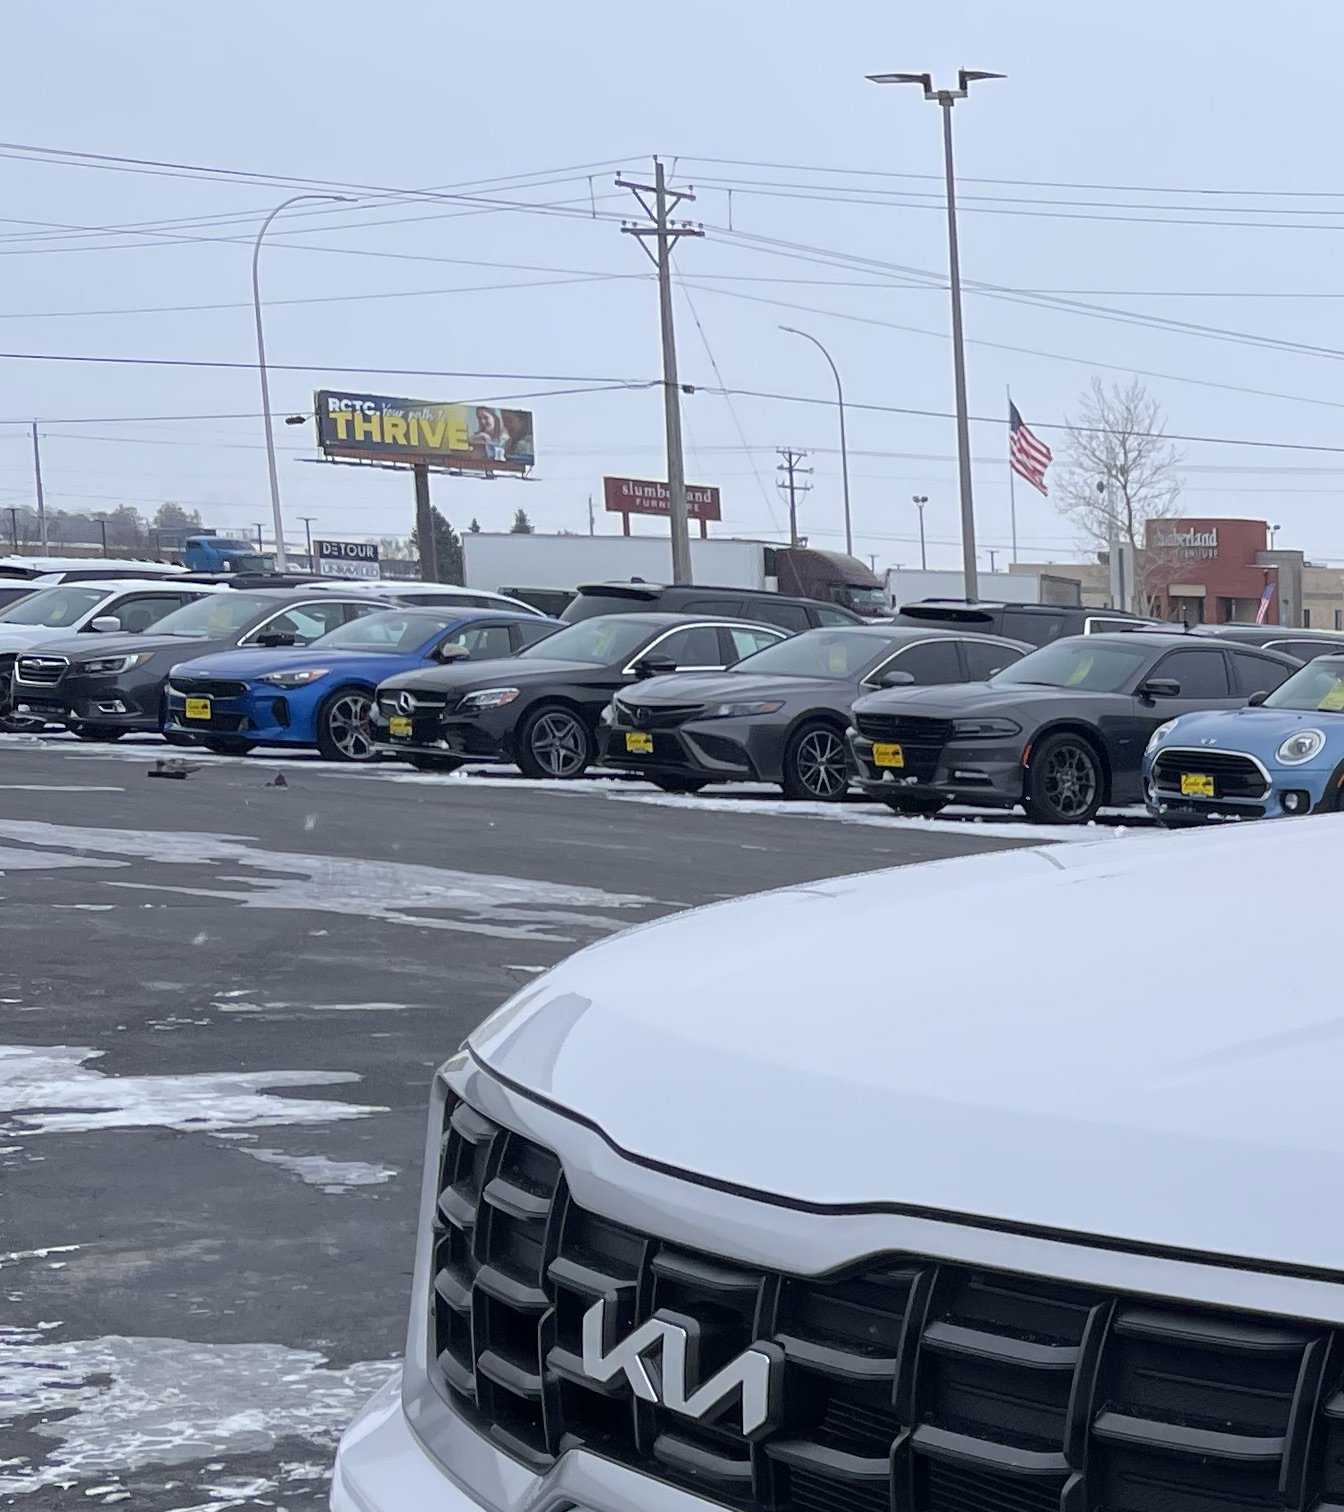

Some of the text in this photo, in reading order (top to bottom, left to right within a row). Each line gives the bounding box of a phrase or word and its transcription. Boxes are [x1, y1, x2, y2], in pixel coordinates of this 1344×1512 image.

[328, 397, 380, 416] RCTC.
[329, 412, 474, 451] THRIVE.
[622, 481, 712, 503] slumband
[322, 542, 375, 558] DETOUR
